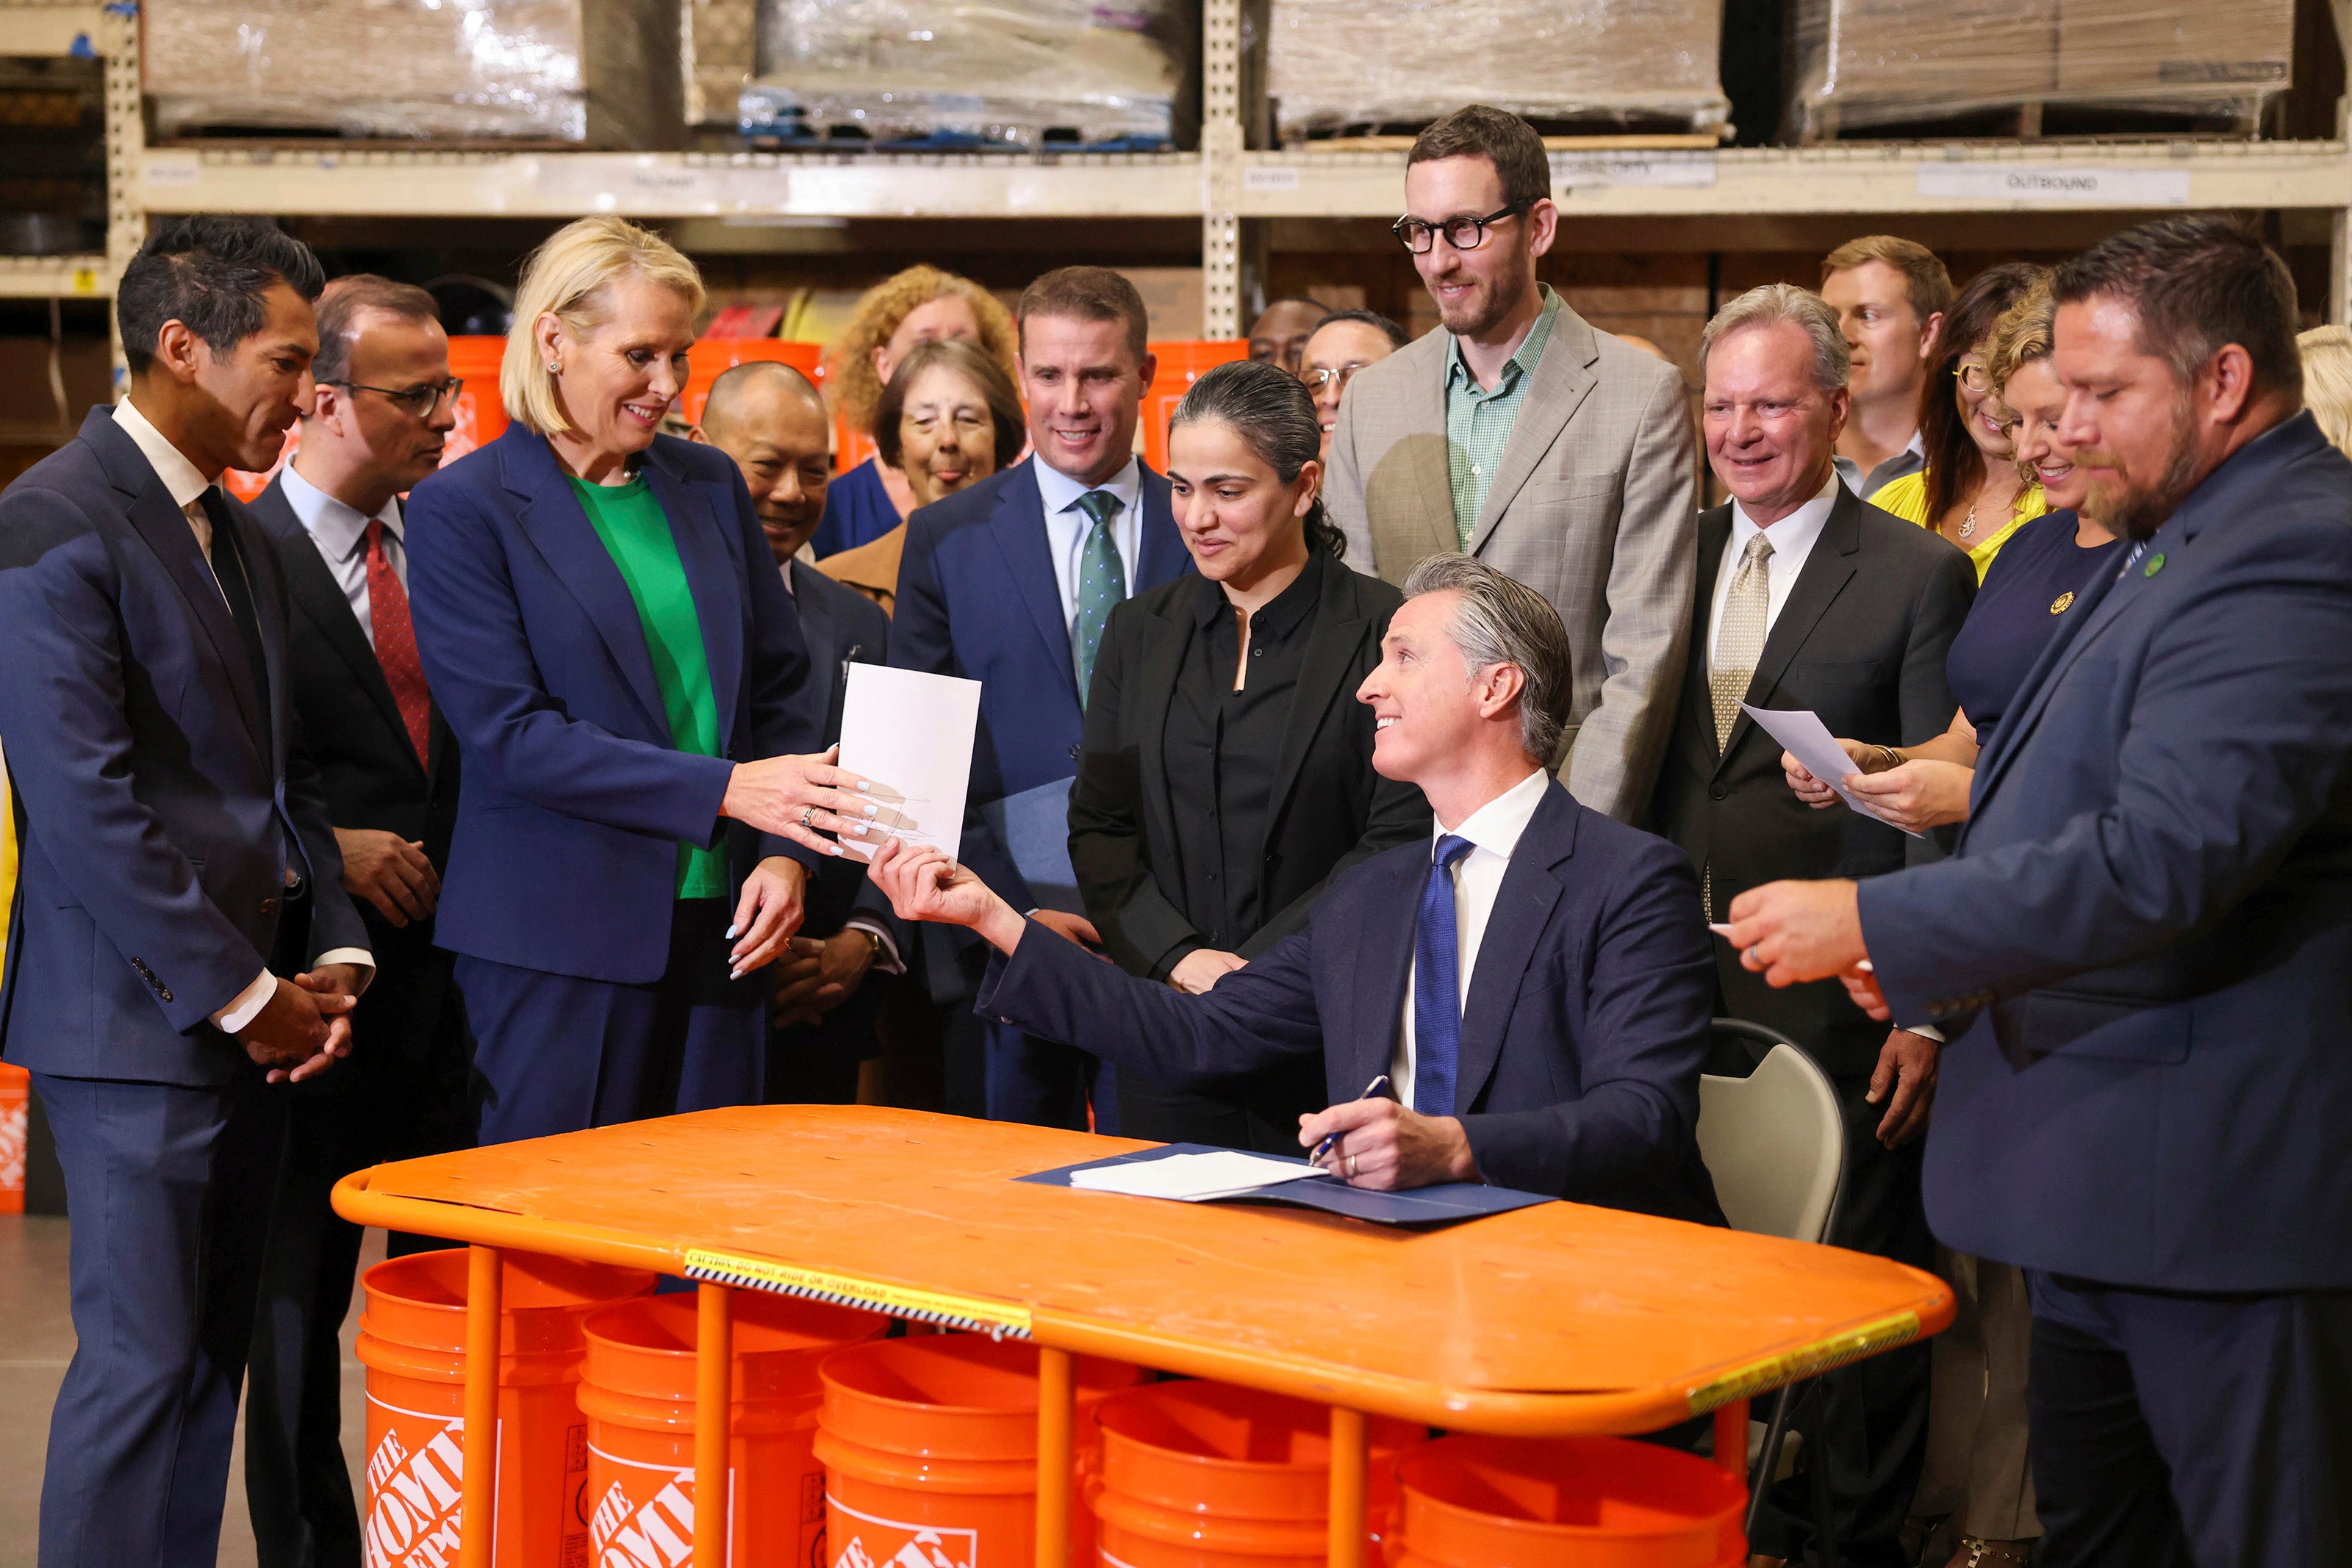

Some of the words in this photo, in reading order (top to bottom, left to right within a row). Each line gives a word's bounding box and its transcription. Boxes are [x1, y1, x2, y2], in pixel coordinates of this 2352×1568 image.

[2007, 173, 2098, 190] OUTBOUND
[736, 1261, 751, 1272] DO
[755, 1263, 775, 1276] NOT
[779, 1268, 804, 1281] RIDE
[809, 1276, 824, 1284] OR
[828, 1279, 887, 1298] OVERLOAD
[368, 1428, 409, 1498] THE
[590, 1480, 635, 1555] THE
